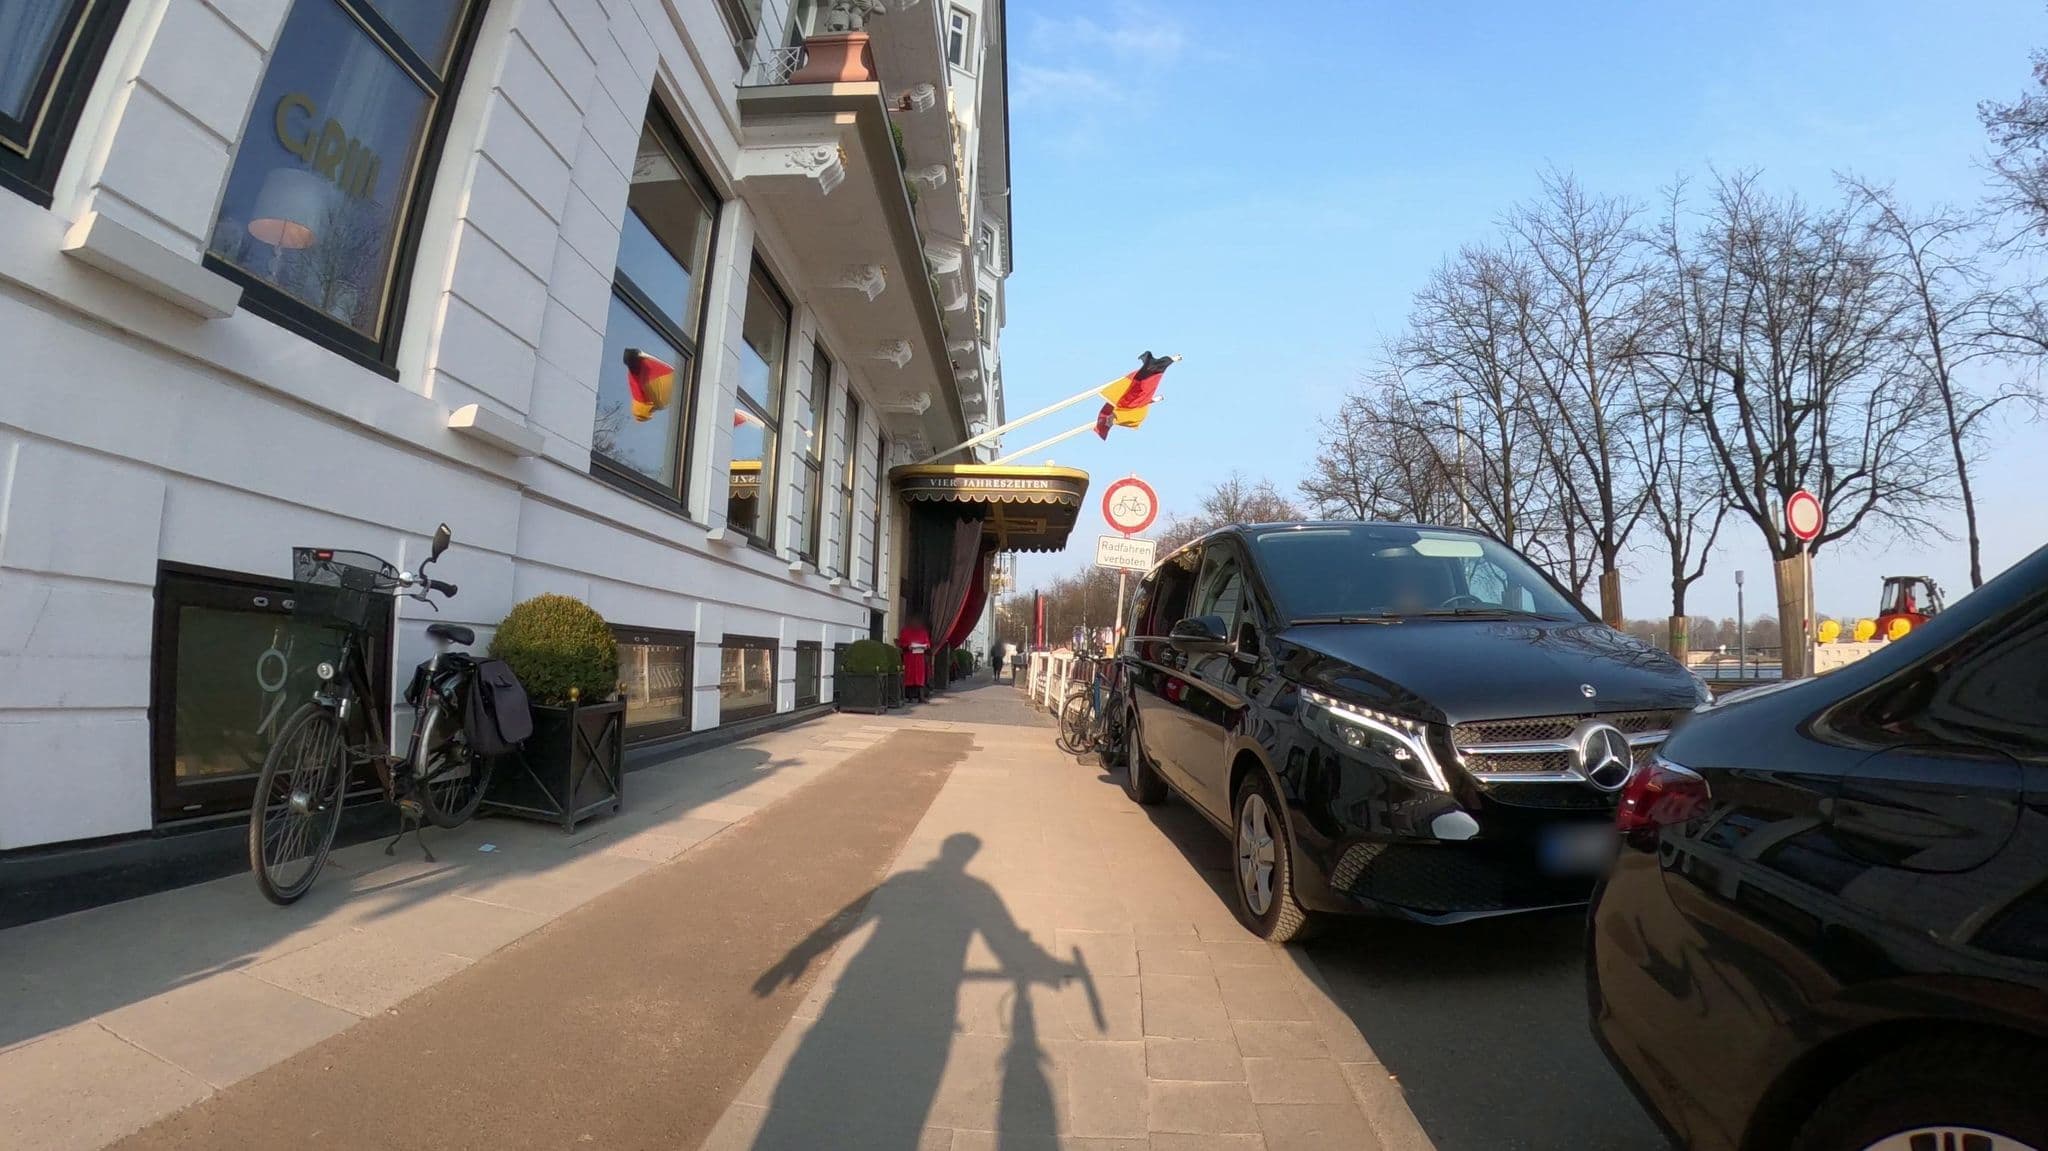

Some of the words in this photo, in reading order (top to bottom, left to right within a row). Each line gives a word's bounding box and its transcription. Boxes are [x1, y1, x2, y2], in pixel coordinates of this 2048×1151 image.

[930, 478, 957, 487] VIER
[963, 479, 1049, 489] JAHRESZEITEN
[1101, 540, 1151, 555] Radfahren
[1103, 554, 1146, 567] verboten
